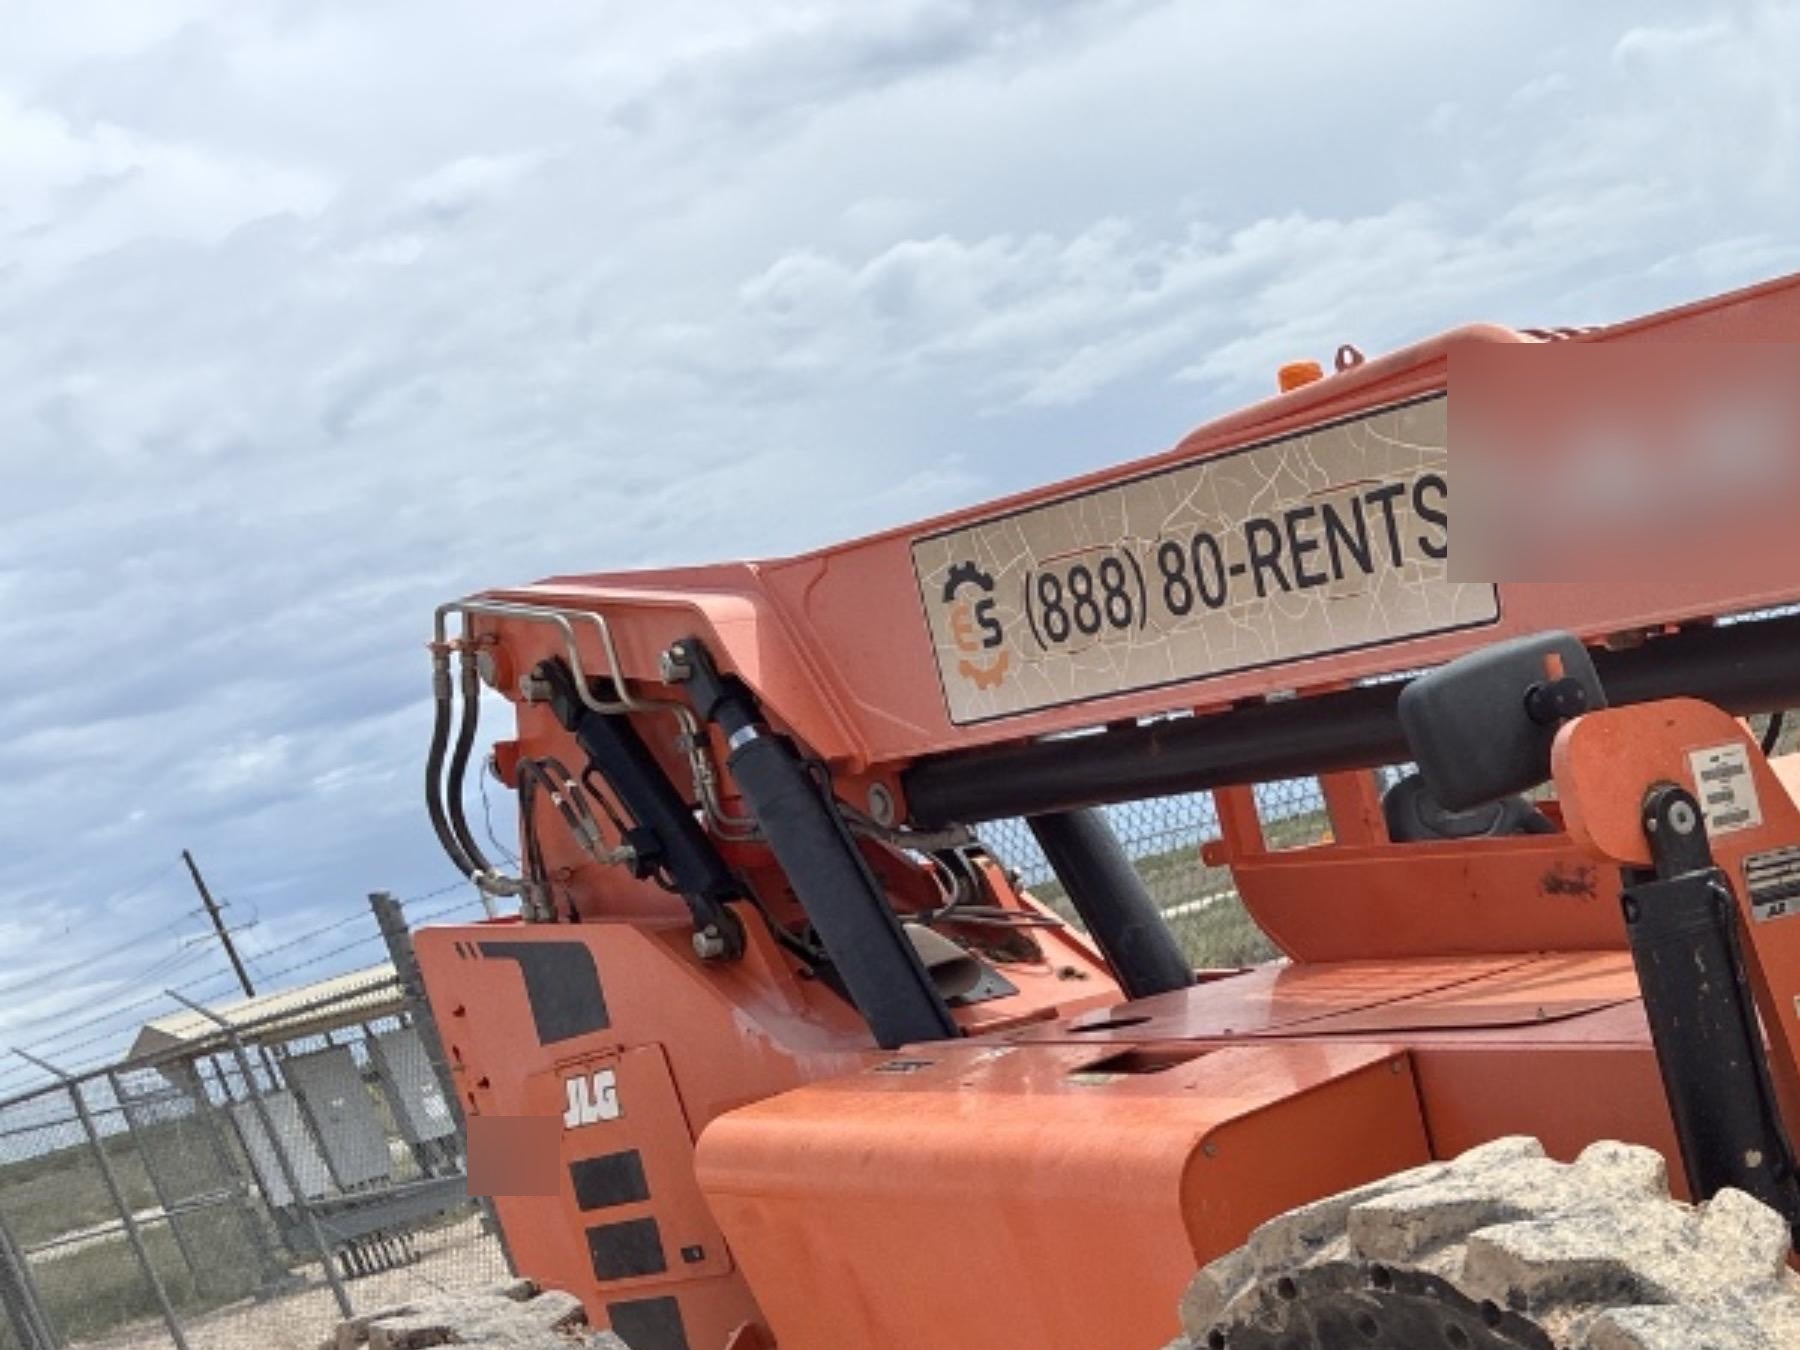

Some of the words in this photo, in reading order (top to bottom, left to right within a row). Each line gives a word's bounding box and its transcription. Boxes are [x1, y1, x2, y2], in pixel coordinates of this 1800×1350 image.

[1025, 546, 1147, 651] (888)
[1158, 474, 1448, 617] 80-RENTS
[563, 1070, 620, 1129] JLG
